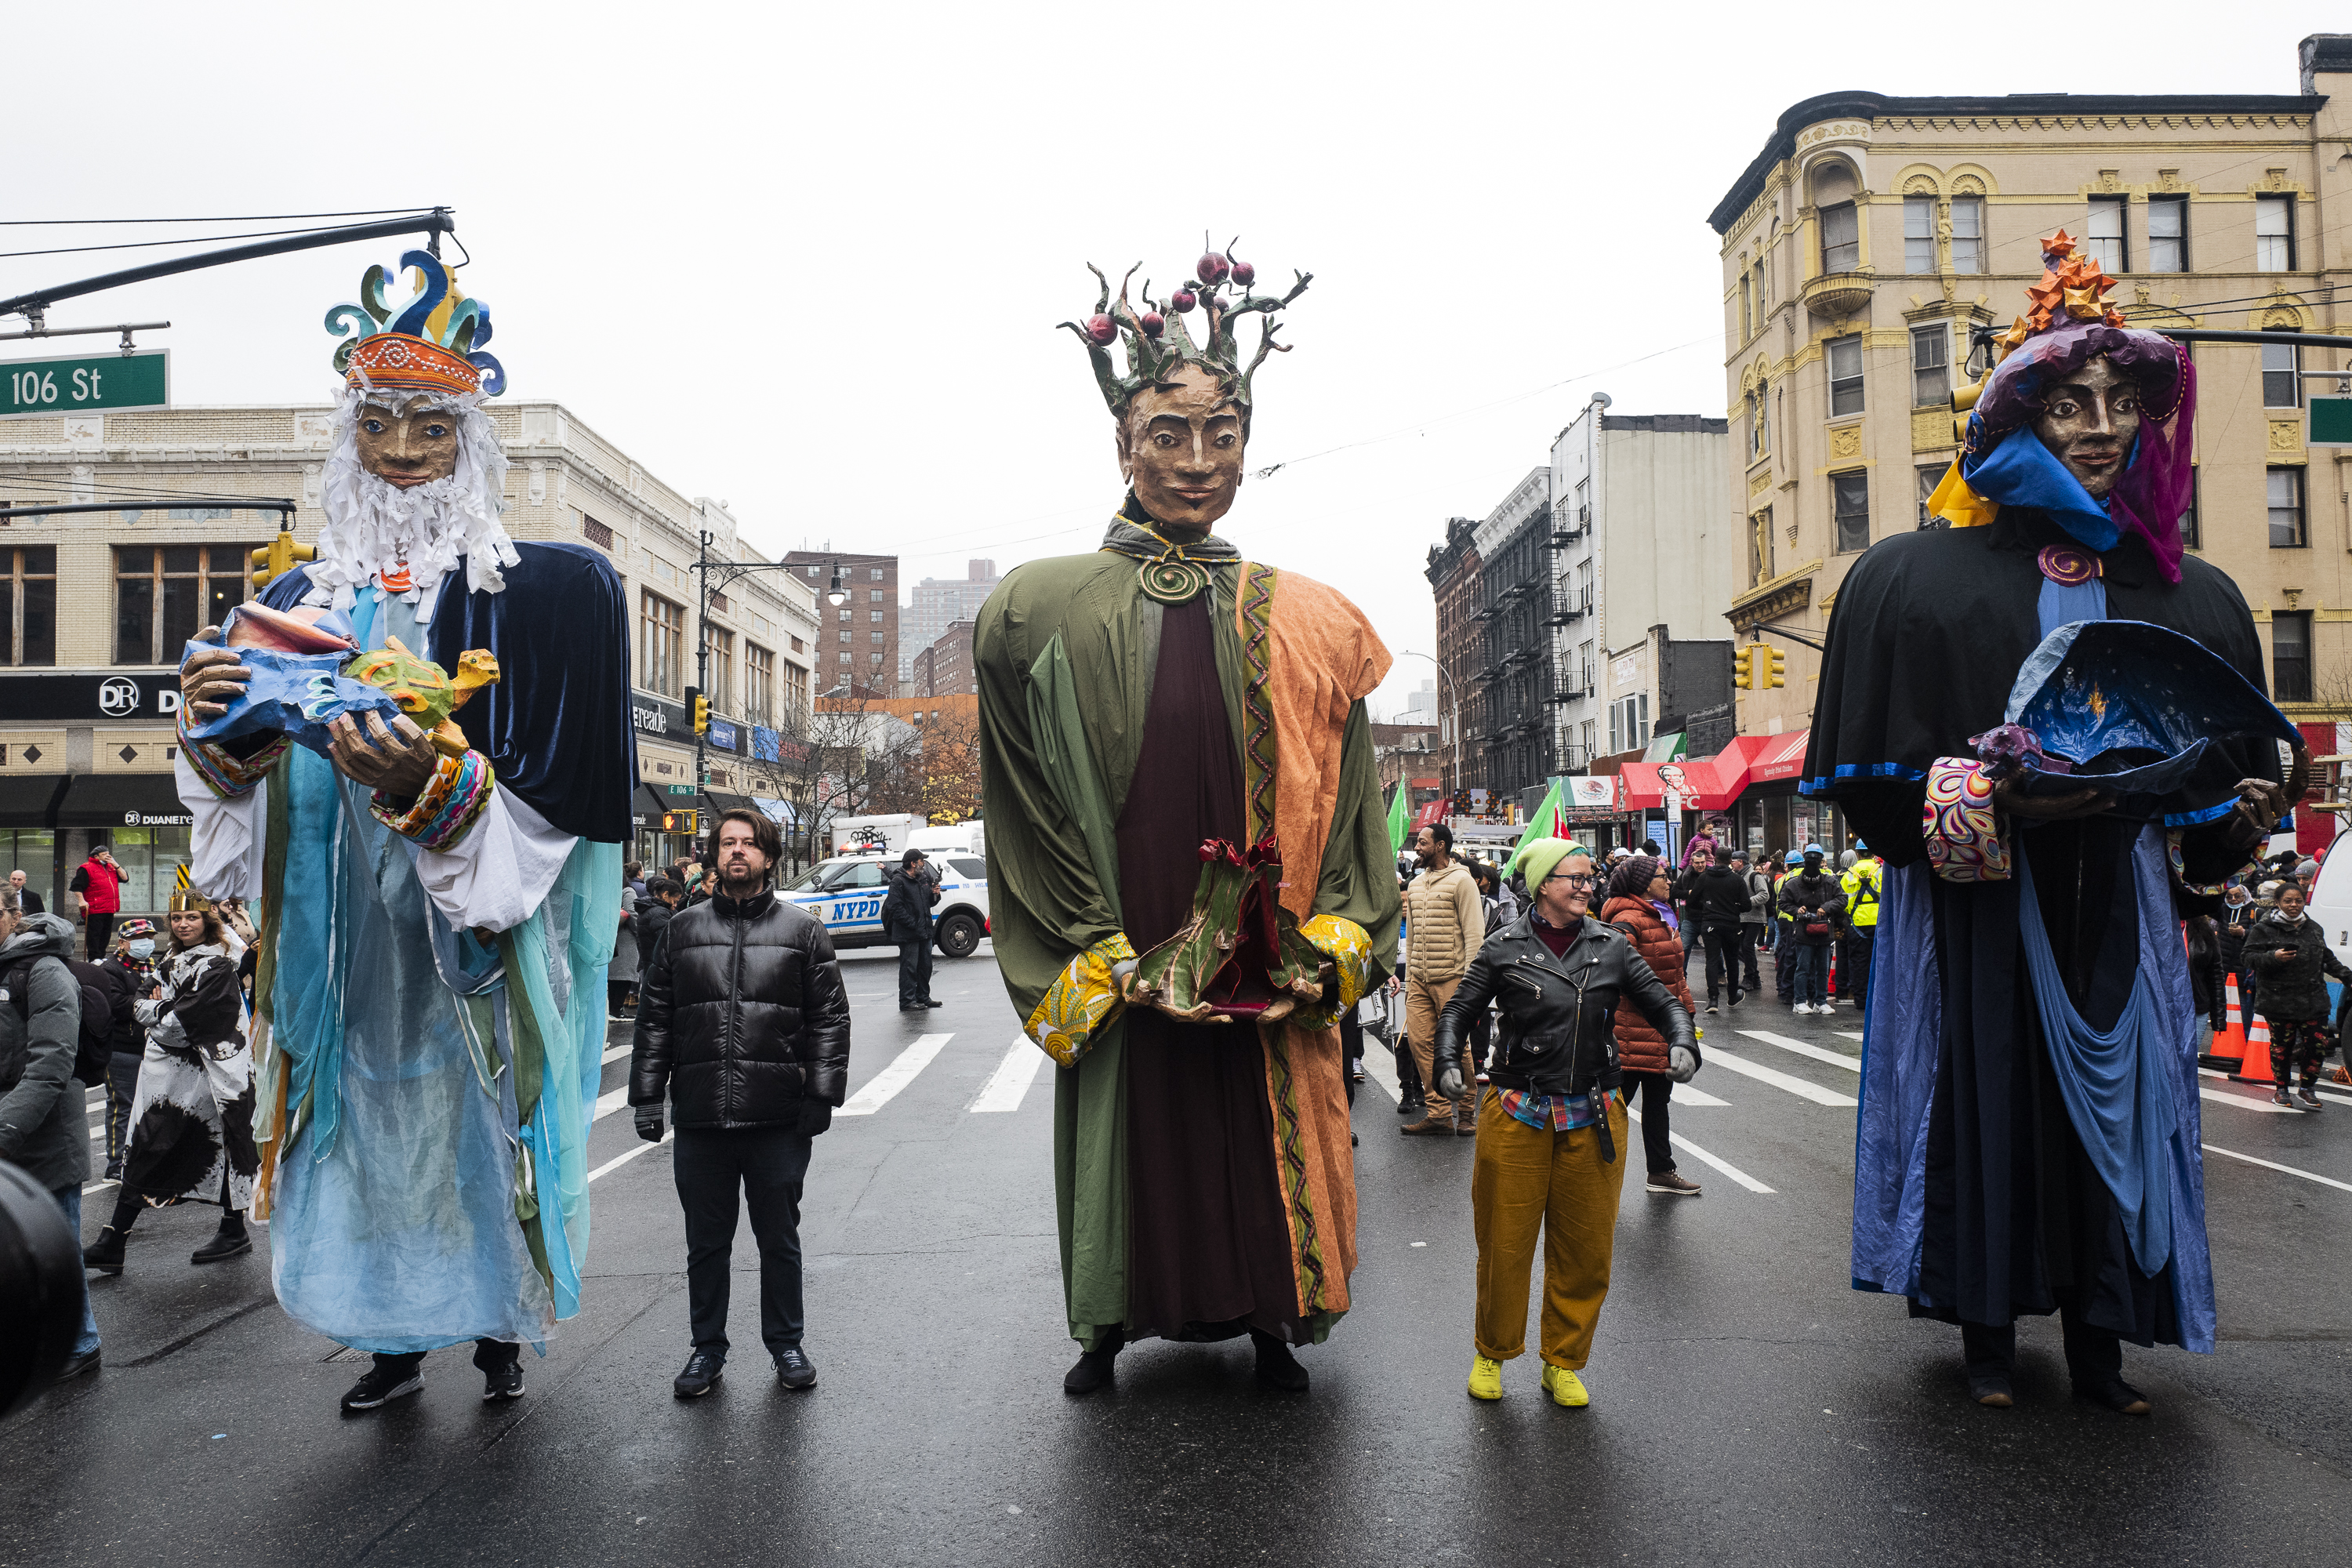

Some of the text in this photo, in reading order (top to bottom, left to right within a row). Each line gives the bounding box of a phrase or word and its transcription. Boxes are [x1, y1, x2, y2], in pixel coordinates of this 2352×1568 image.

[12, 368, 102, 405] 106 St
[677, 786, 687, 794] 106
[832, 900, 880, 921] NYPD
